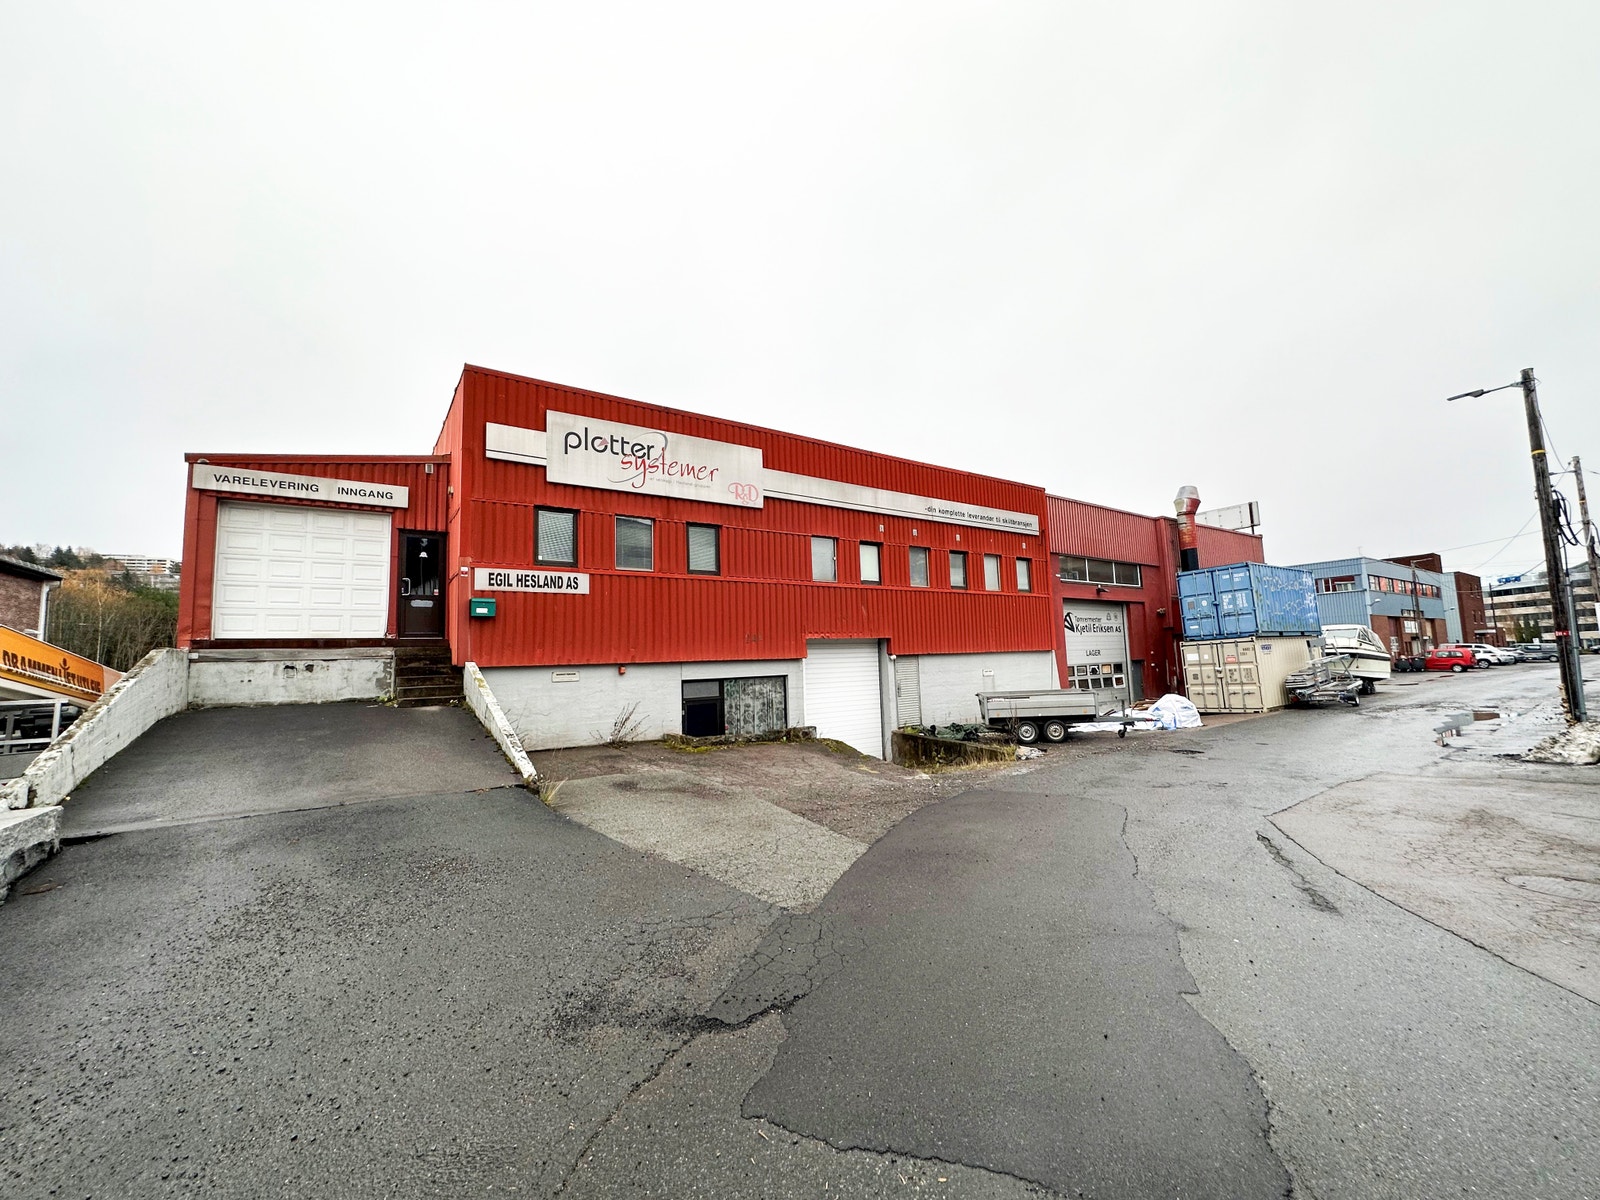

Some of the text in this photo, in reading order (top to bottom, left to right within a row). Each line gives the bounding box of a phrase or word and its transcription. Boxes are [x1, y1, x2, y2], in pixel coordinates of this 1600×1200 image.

[564, 427, 655, 460] plotter
[620, 447, 719, 489] systemer
[213, 474, 393, 499] VARELEVERING INNGANG
[938, 507, 966, 518] komplette
[1002, 518, 1033, 528] skiltbransjen
[488, 572, 579, 590] EGIL HESLAND AS
[1075, 623, 1092, 635] Kjetil
[1092, 623, 1114, 633] Eriksen
[1085, 649, 1101, 657] LAGER
